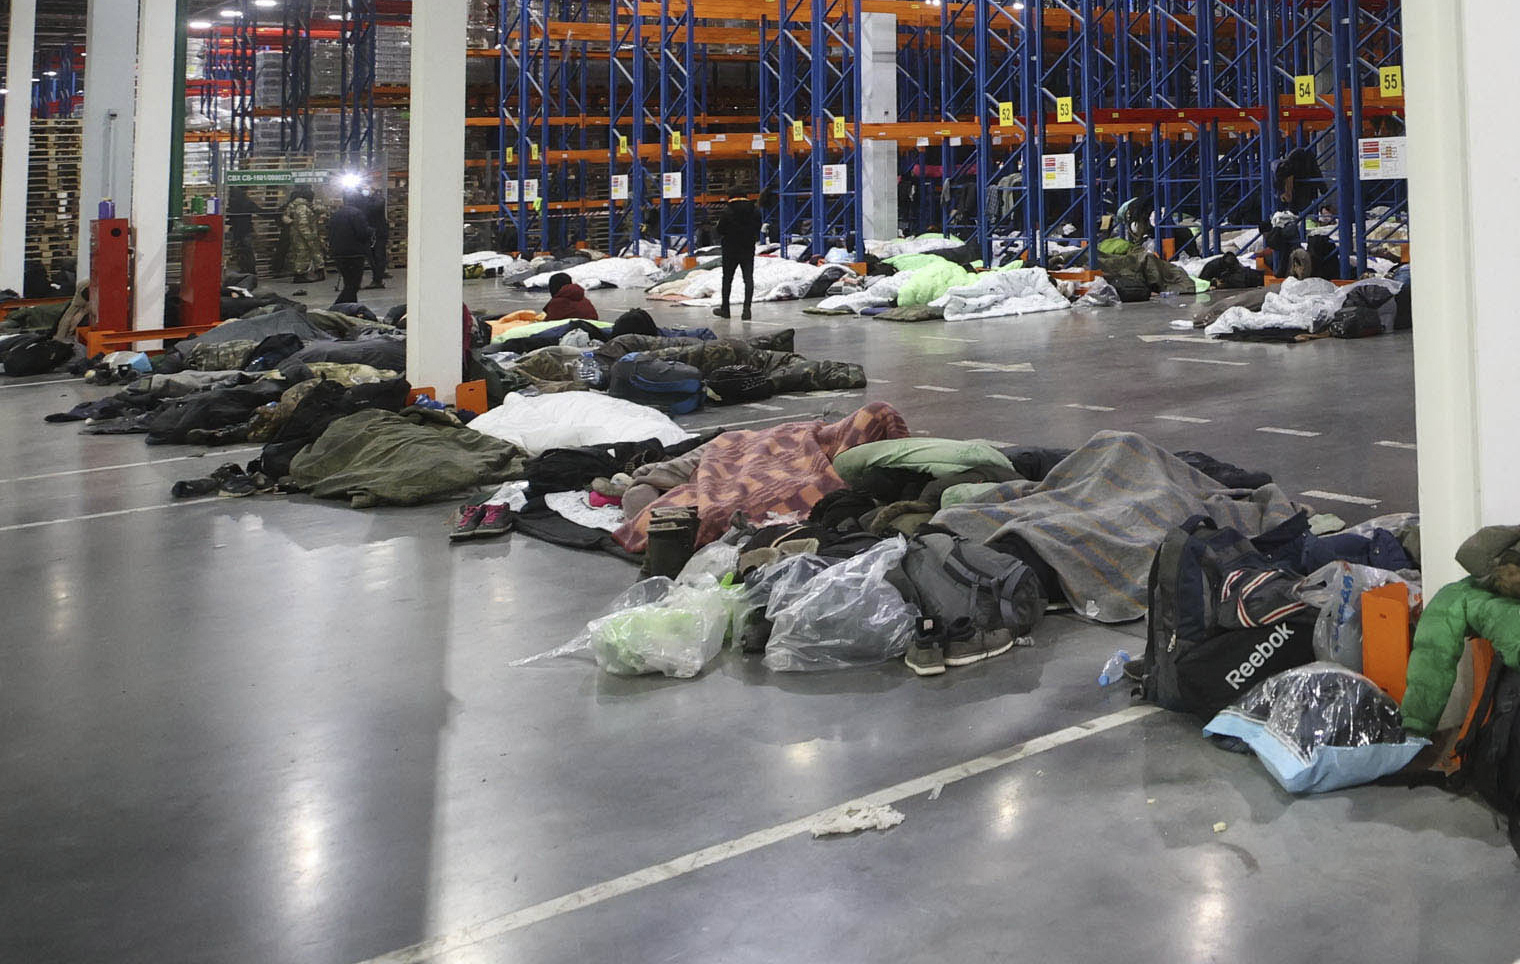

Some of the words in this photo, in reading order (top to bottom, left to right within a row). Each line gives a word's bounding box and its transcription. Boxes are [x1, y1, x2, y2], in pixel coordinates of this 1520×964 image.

[1384, 73, 1398, 90] 55
[1299, 82, 1311, 98] 54
[1001, 107, 1011, 121] 52
[1060, 103, 1070, 117] 53
[1225, 622, 1295, 690] Reebok
